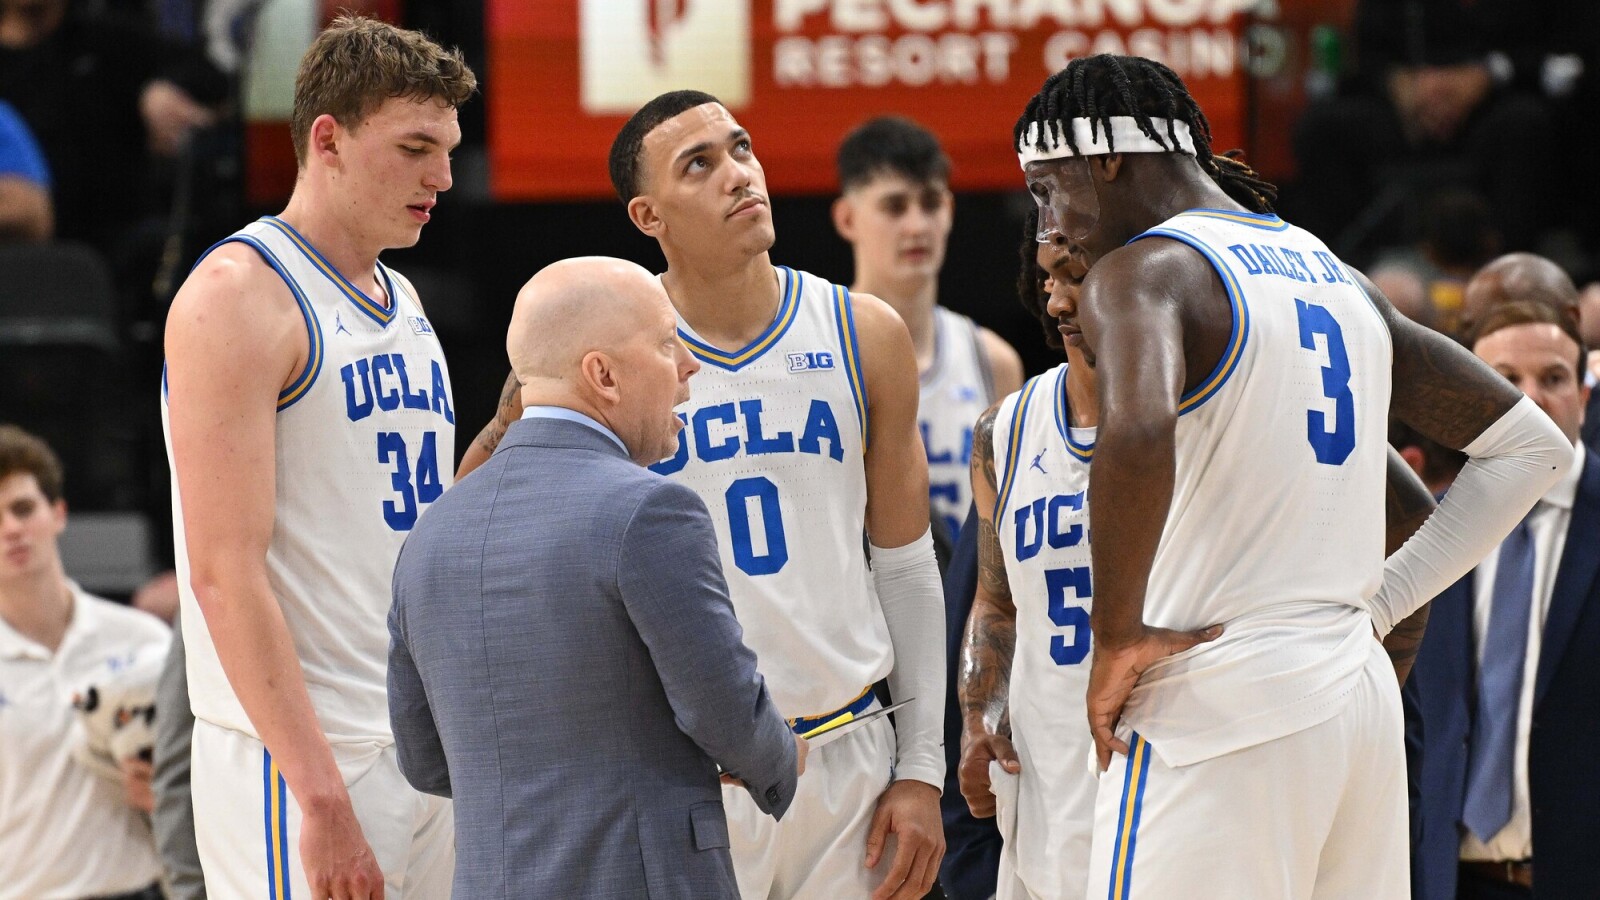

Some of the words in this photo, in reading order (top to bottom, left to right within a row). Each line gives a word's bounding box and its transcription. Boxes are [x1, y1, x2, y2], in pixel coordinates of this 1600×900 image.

[773, 33, 1018, 86] RESORT
[1227, 243, 1317, 283] DAILEY
[340, 353, 455, 423] UCLA
[1294, 298, 1356, 466] 3
[377, 431, 444, 531] 34
[725, 476, 789, 577] 0
[1014, 488, 1091, 562] UC
[1044, 566, 1093, 666] 5
